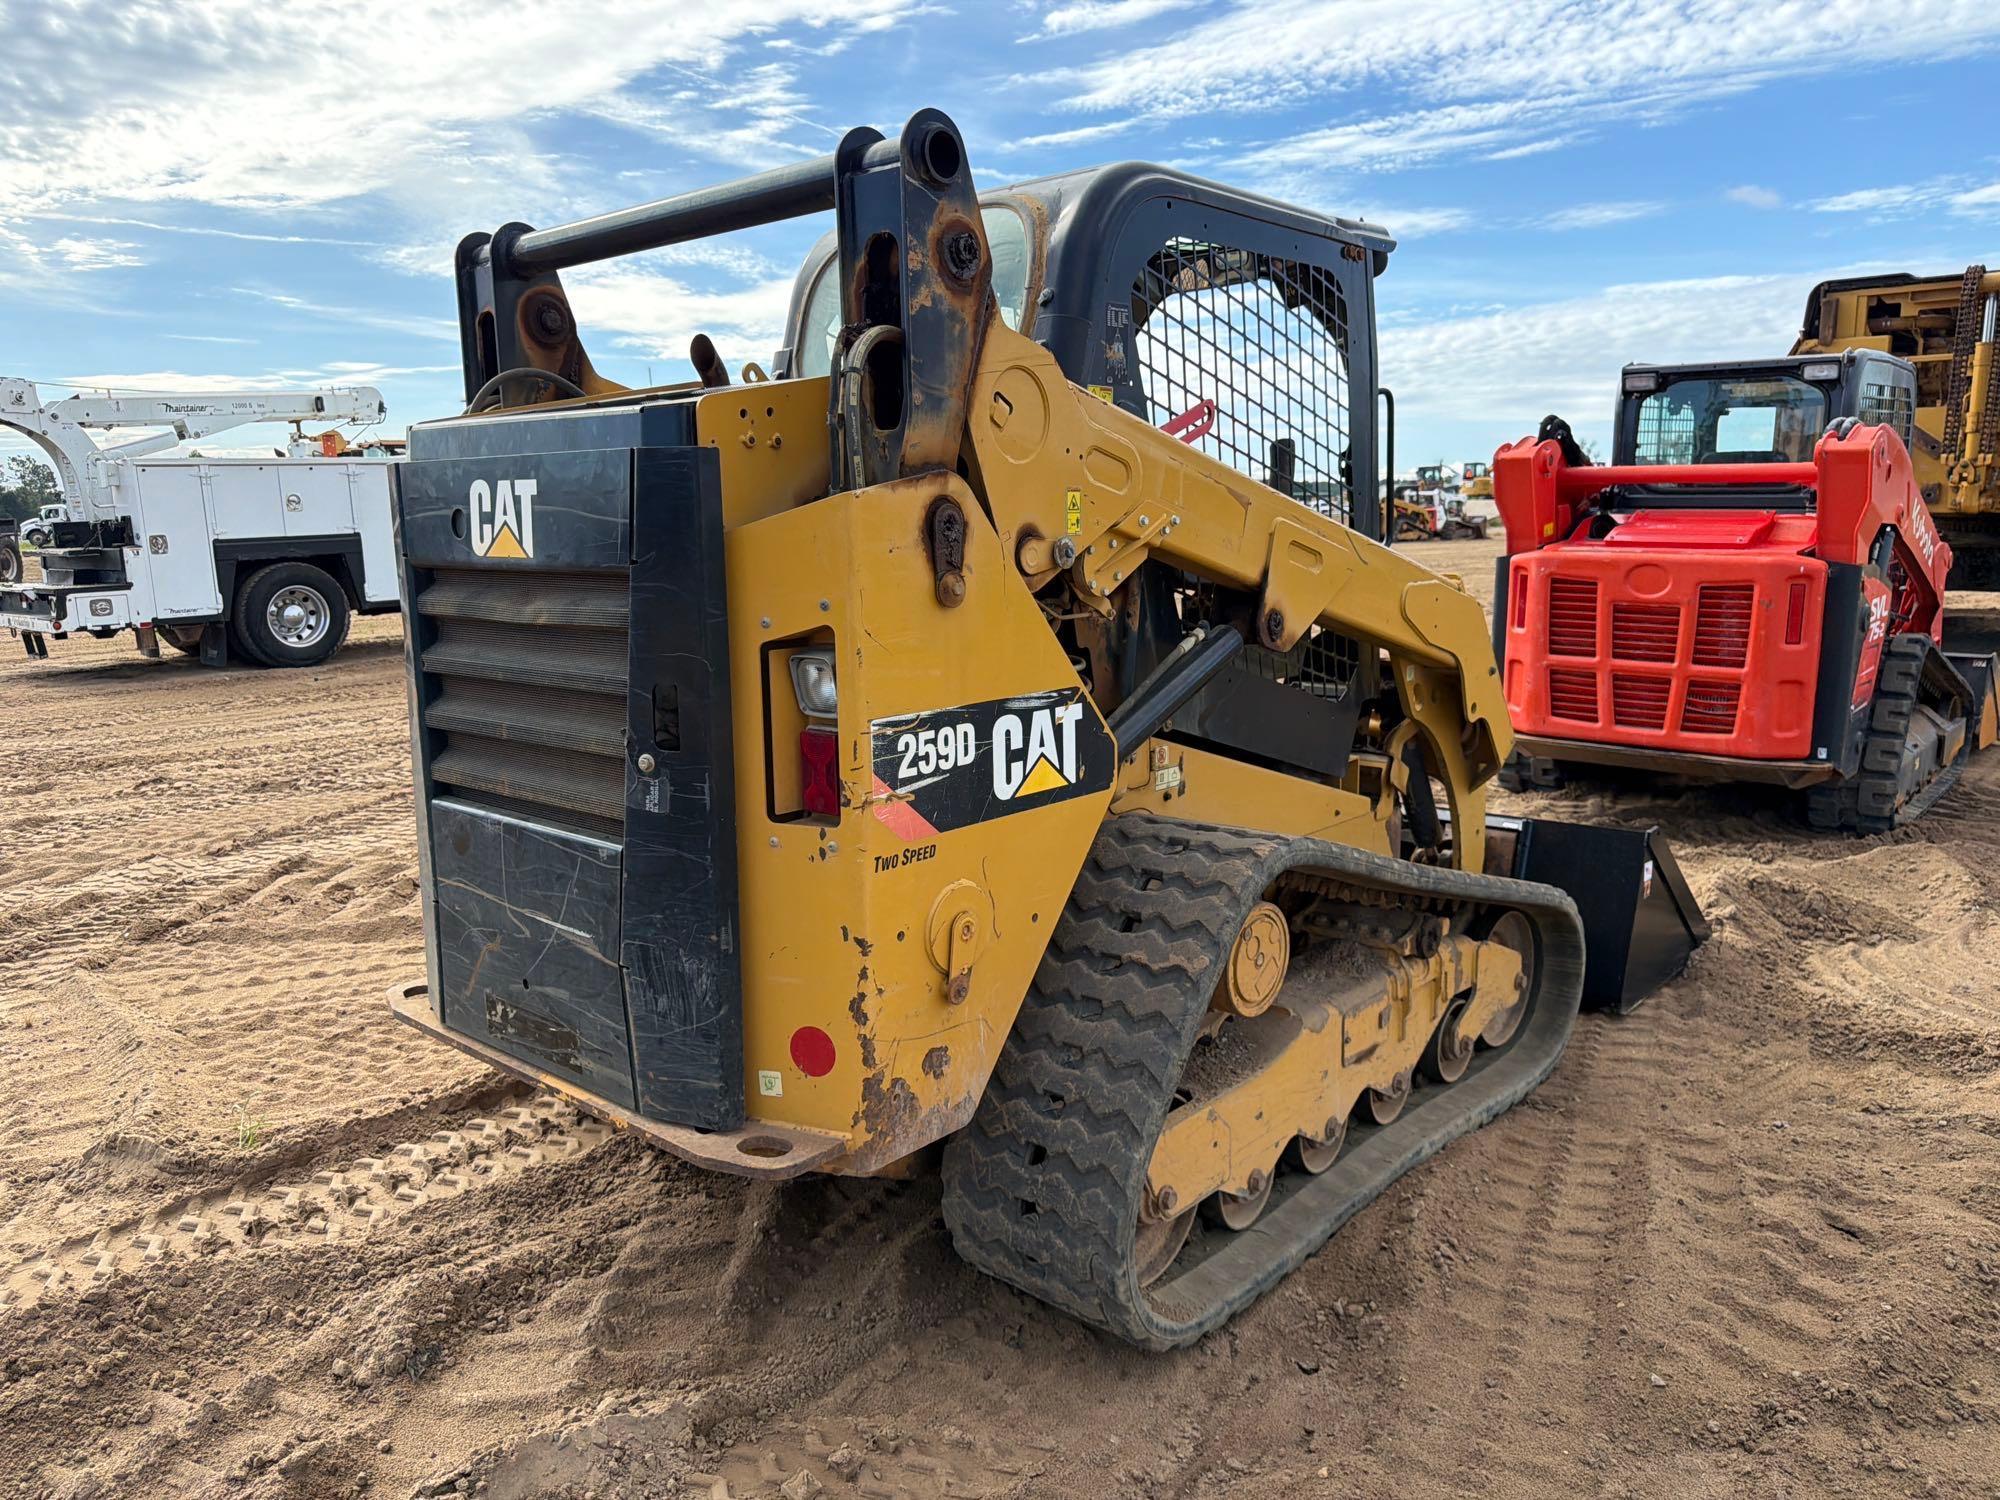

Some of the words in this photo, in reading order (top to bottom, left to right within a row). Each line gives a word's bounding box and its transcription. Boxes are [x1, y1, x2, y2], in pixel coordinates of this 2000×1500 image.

[157, 403, 214, 413] Maintainer
[469, 478, 537, 559] CAT
[1869, 594, 1889, 622] SVL
[897, 722, 976, 779] 259D
[992, 703, 1083, 801] CAT
